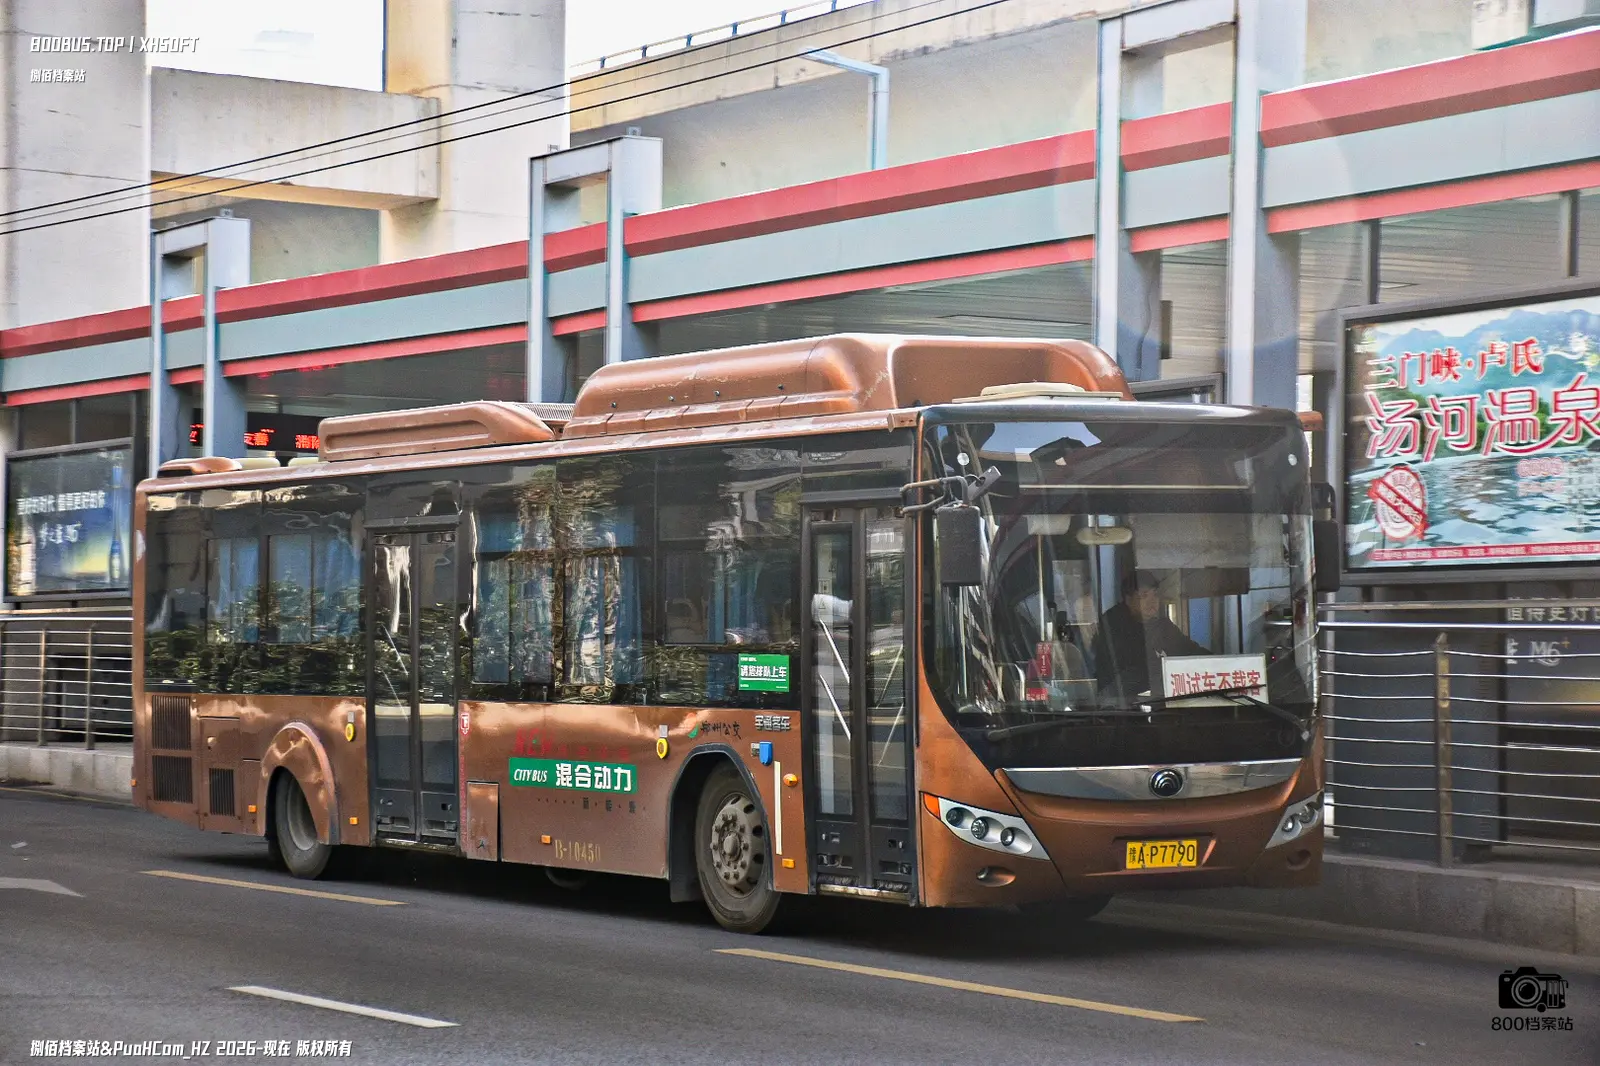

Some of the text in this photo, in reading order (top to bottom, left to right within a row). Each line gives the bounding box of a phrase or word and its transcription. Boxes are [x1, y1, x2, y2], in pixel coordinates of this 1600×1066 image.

[1365, 338, 1543, 390] 三门峡·卢氏
[1365, 373, 1600, 463] 汤河温泉
[740, 665, 787, 678] 请您排队上车
[1170, 670, 1261, 697] 测试车不载客
[513, 769, 548, 783] CITY BUS
[556, 763, 632, 792] 混合动力
